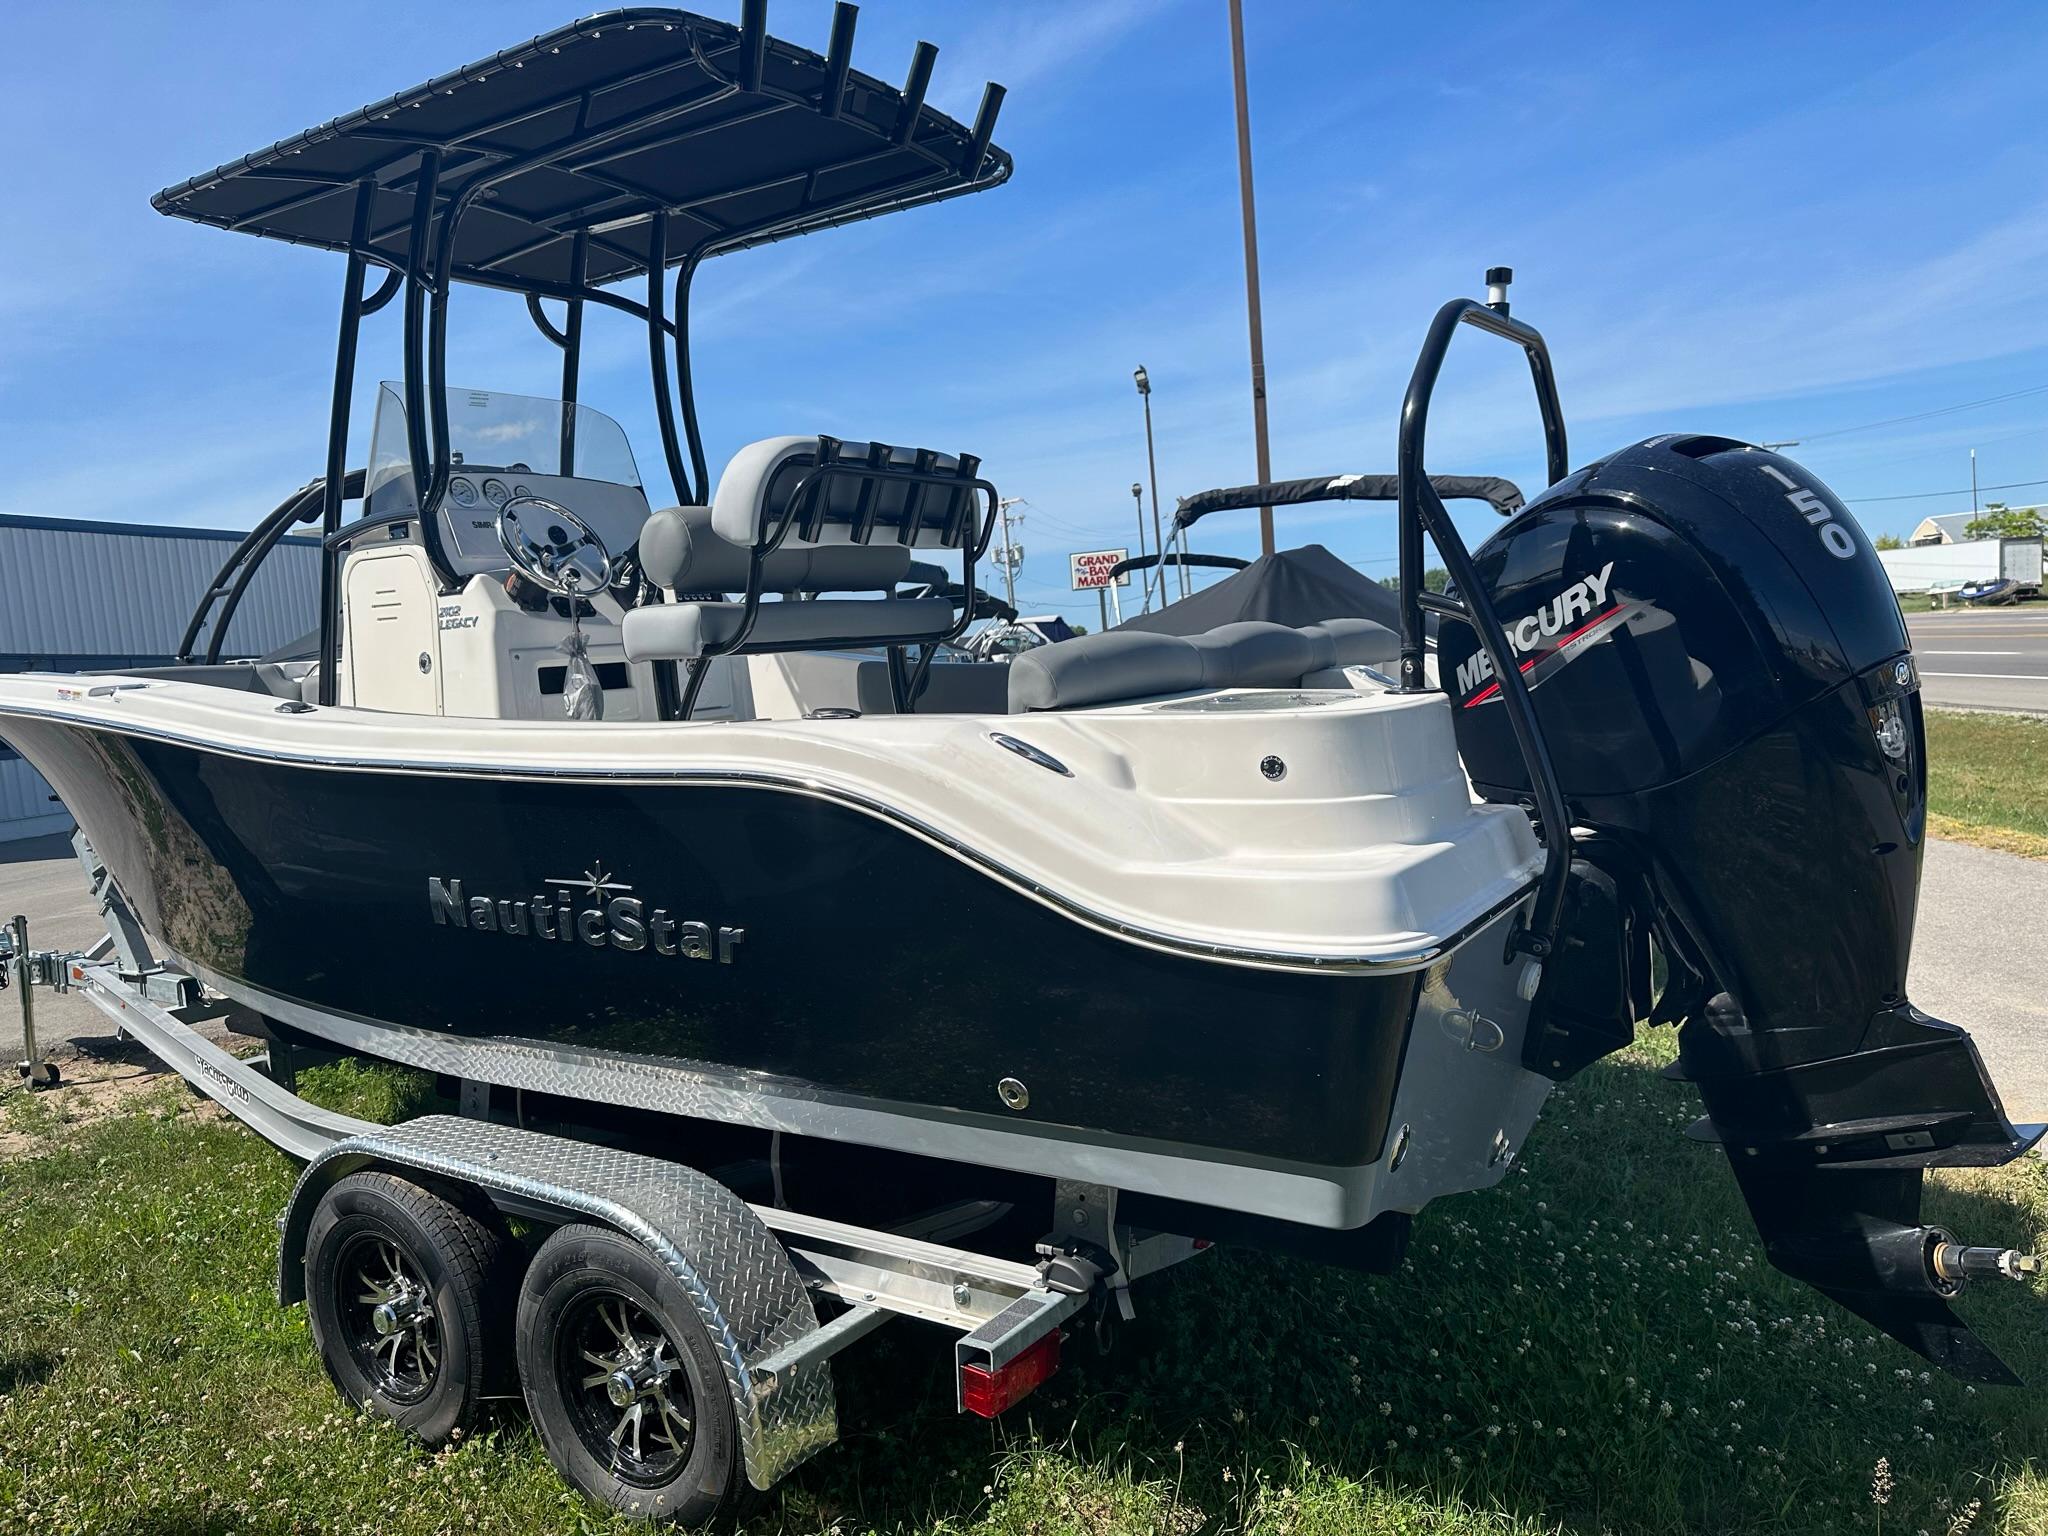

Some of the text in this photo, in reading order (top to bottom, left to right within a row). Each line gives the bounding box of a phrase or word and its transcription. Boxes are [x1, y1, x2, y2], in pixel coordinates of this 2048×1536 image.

[1759, 464, 1857, 560] 150
[1078, 554, 1119, 567] GRAND
[1089, 565, 1111, 577] BAY
[439, 615, 479, 630] LEGACY
[428, 876, 745, 964] NauticStar
